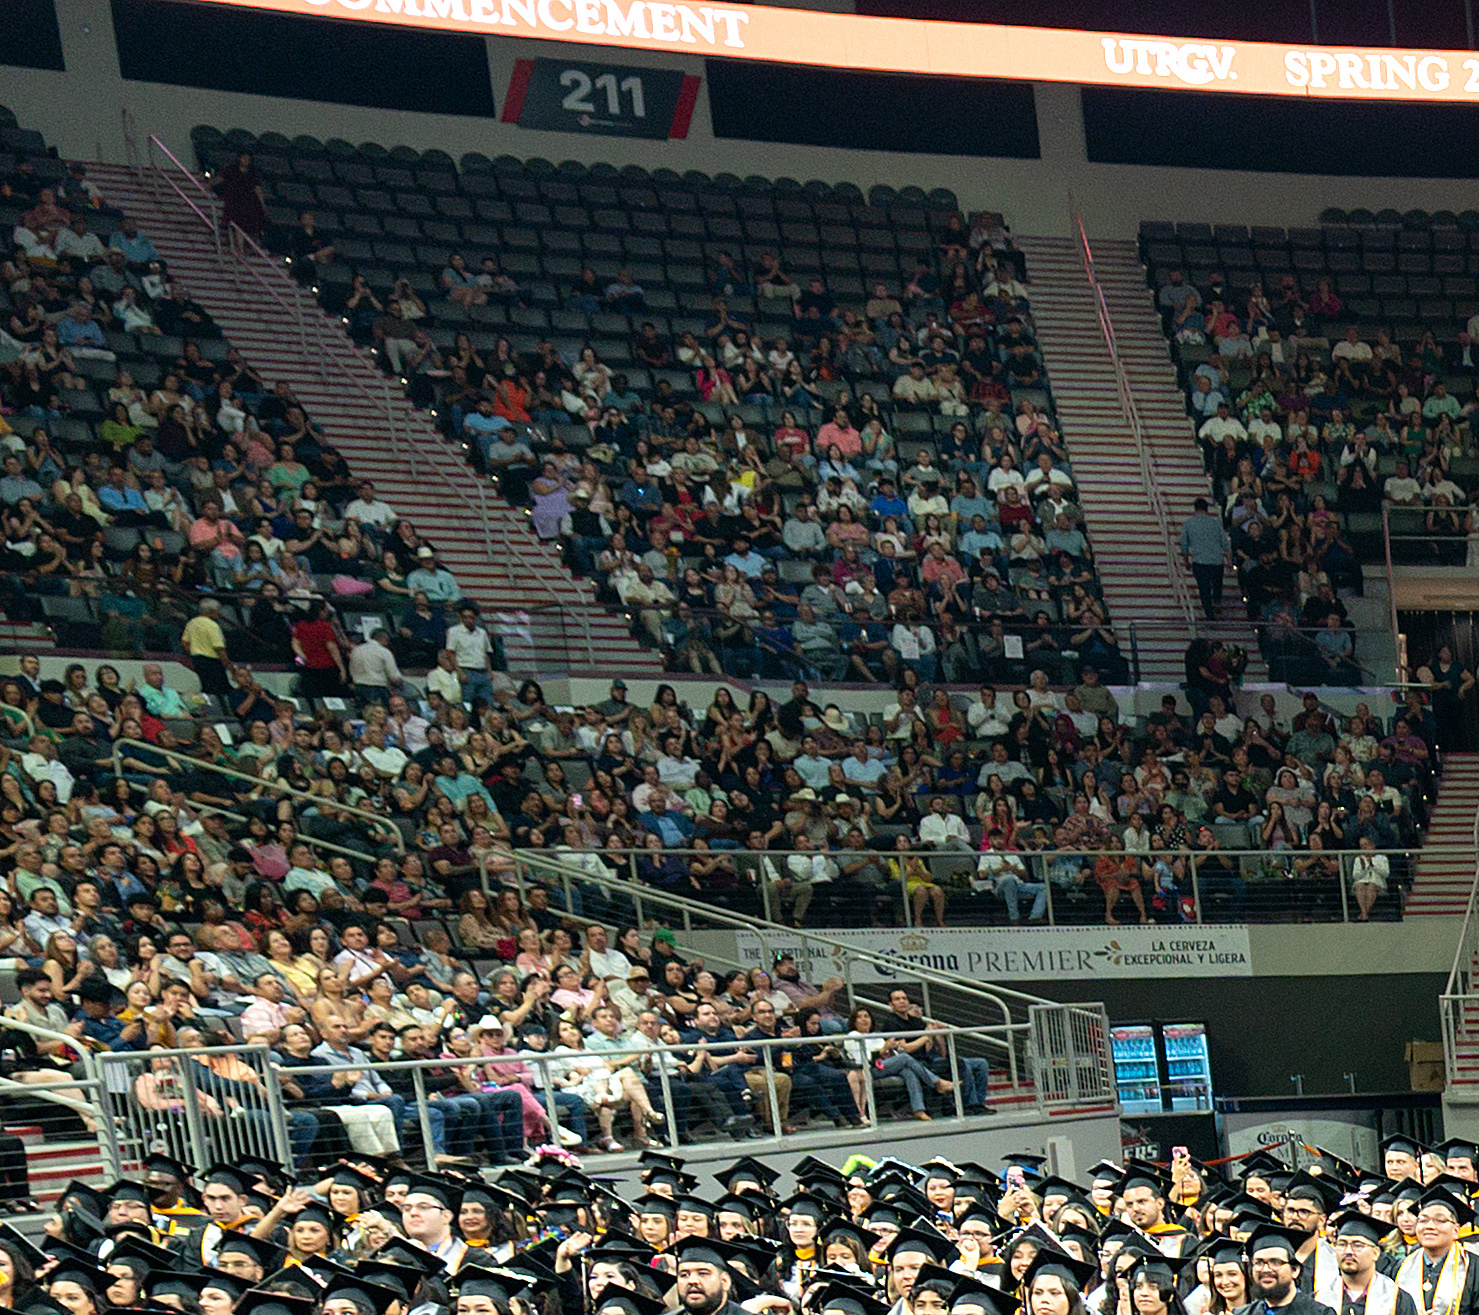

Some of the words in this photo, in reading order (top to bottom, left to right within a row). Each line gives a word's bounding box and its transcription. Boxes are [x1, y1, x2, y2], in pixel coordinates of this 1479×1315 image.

[305, 0, 750, 47] ENCEMENT
[1284, 50, 1451, 93] SPRING
[559, 69, 646, 117] 211
[967, 950, 1095, 973] PREMIER
[1124, 954, 1193, 966] EXCEPCIONAL
[1197, 953, 1205, 965] Y
[1208, 952, 1246, 965] LIGERA
[1151, 940, 1166, 952] LA
[1169, 940, 1216, 952] CERVEZA
